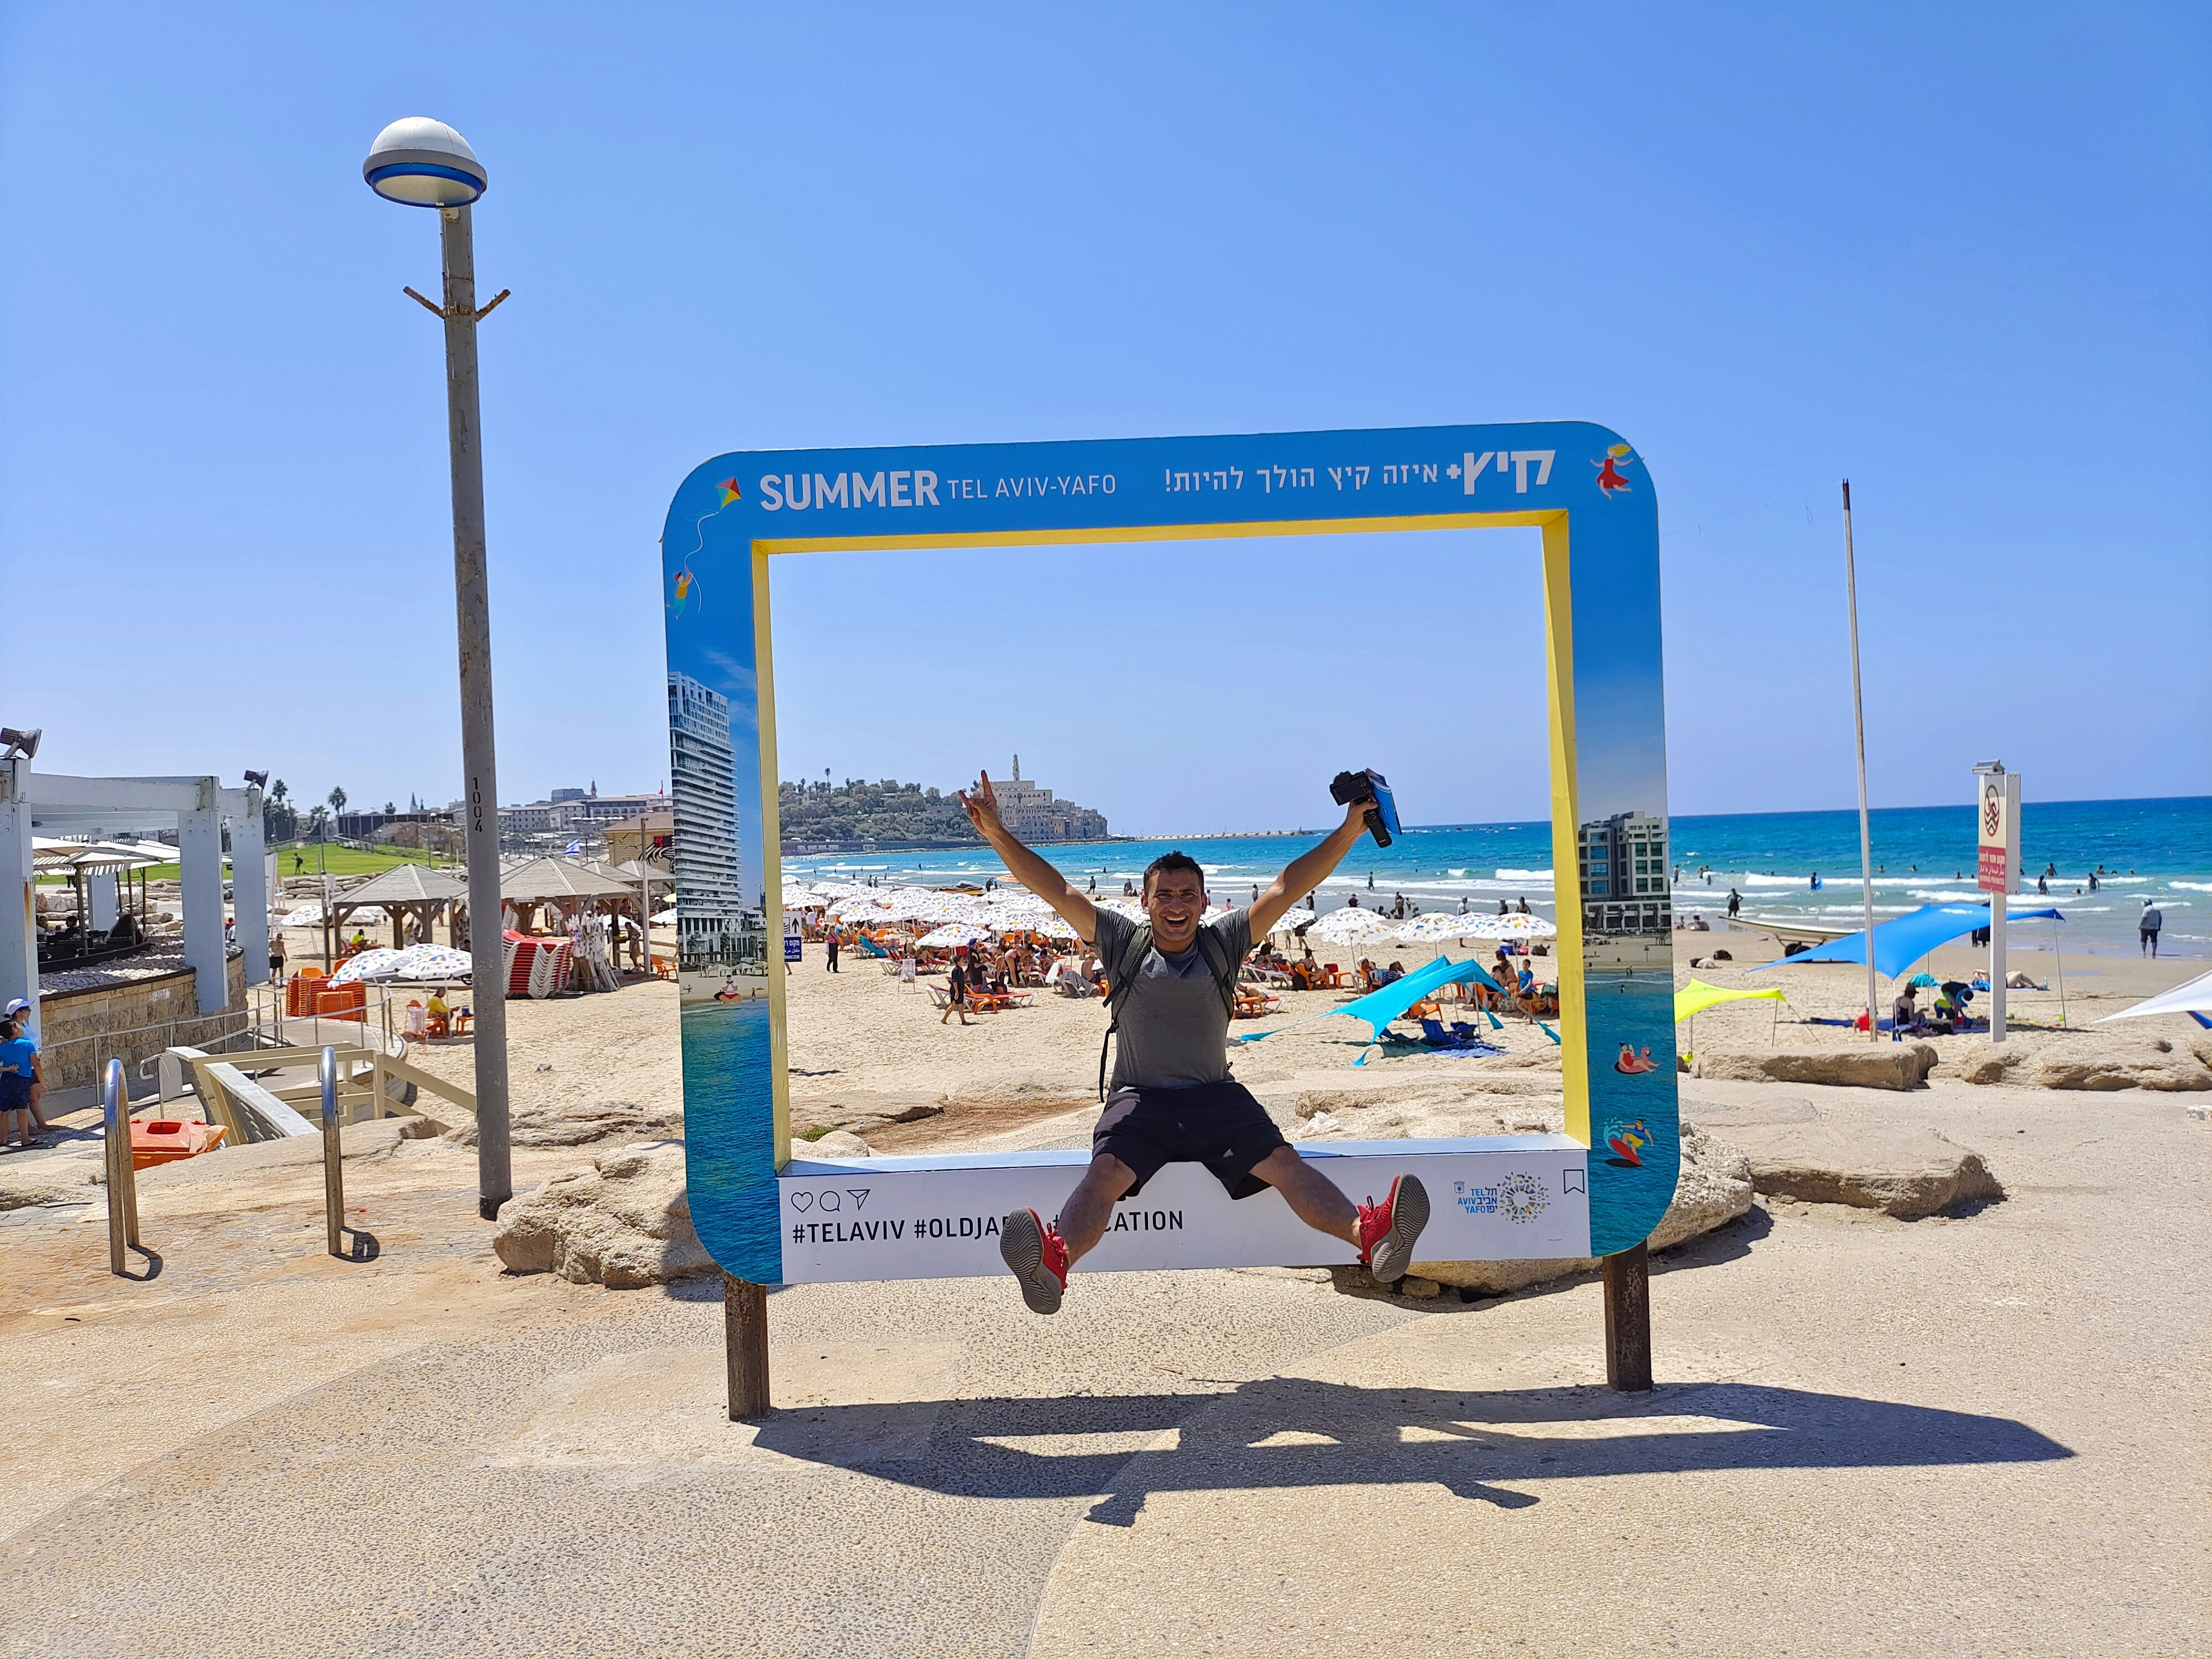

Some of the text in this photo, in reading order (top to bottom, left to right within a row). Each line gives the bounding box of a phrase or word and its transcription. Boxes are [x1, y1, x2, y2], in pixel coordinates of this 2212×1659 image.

[1165, 466, 1244, 492] להיות!
[1256, 464, 1314, 494] הולך
[1327, 466, 1370, 491] קיץ
[1383, 463, 1438, 485] איזה
[760, 469, 1116, 512] SUMMER TEL AVIV-YAFO
[472, 776, 483, 833] 1004
[1457, 1197, 1476, 1205] AVIV
[1470, 1188, 1485, 1196] TEL
[1477, 1196, 1498, 1205] אביב
[1485, 1186, 1498, 1196] תל
[1486, 1205, 1498, 1213] יפו
[792, 1219, 905, 1244] #TELAVIV
[914, 1215, 1011, 1240] #OLDJA
